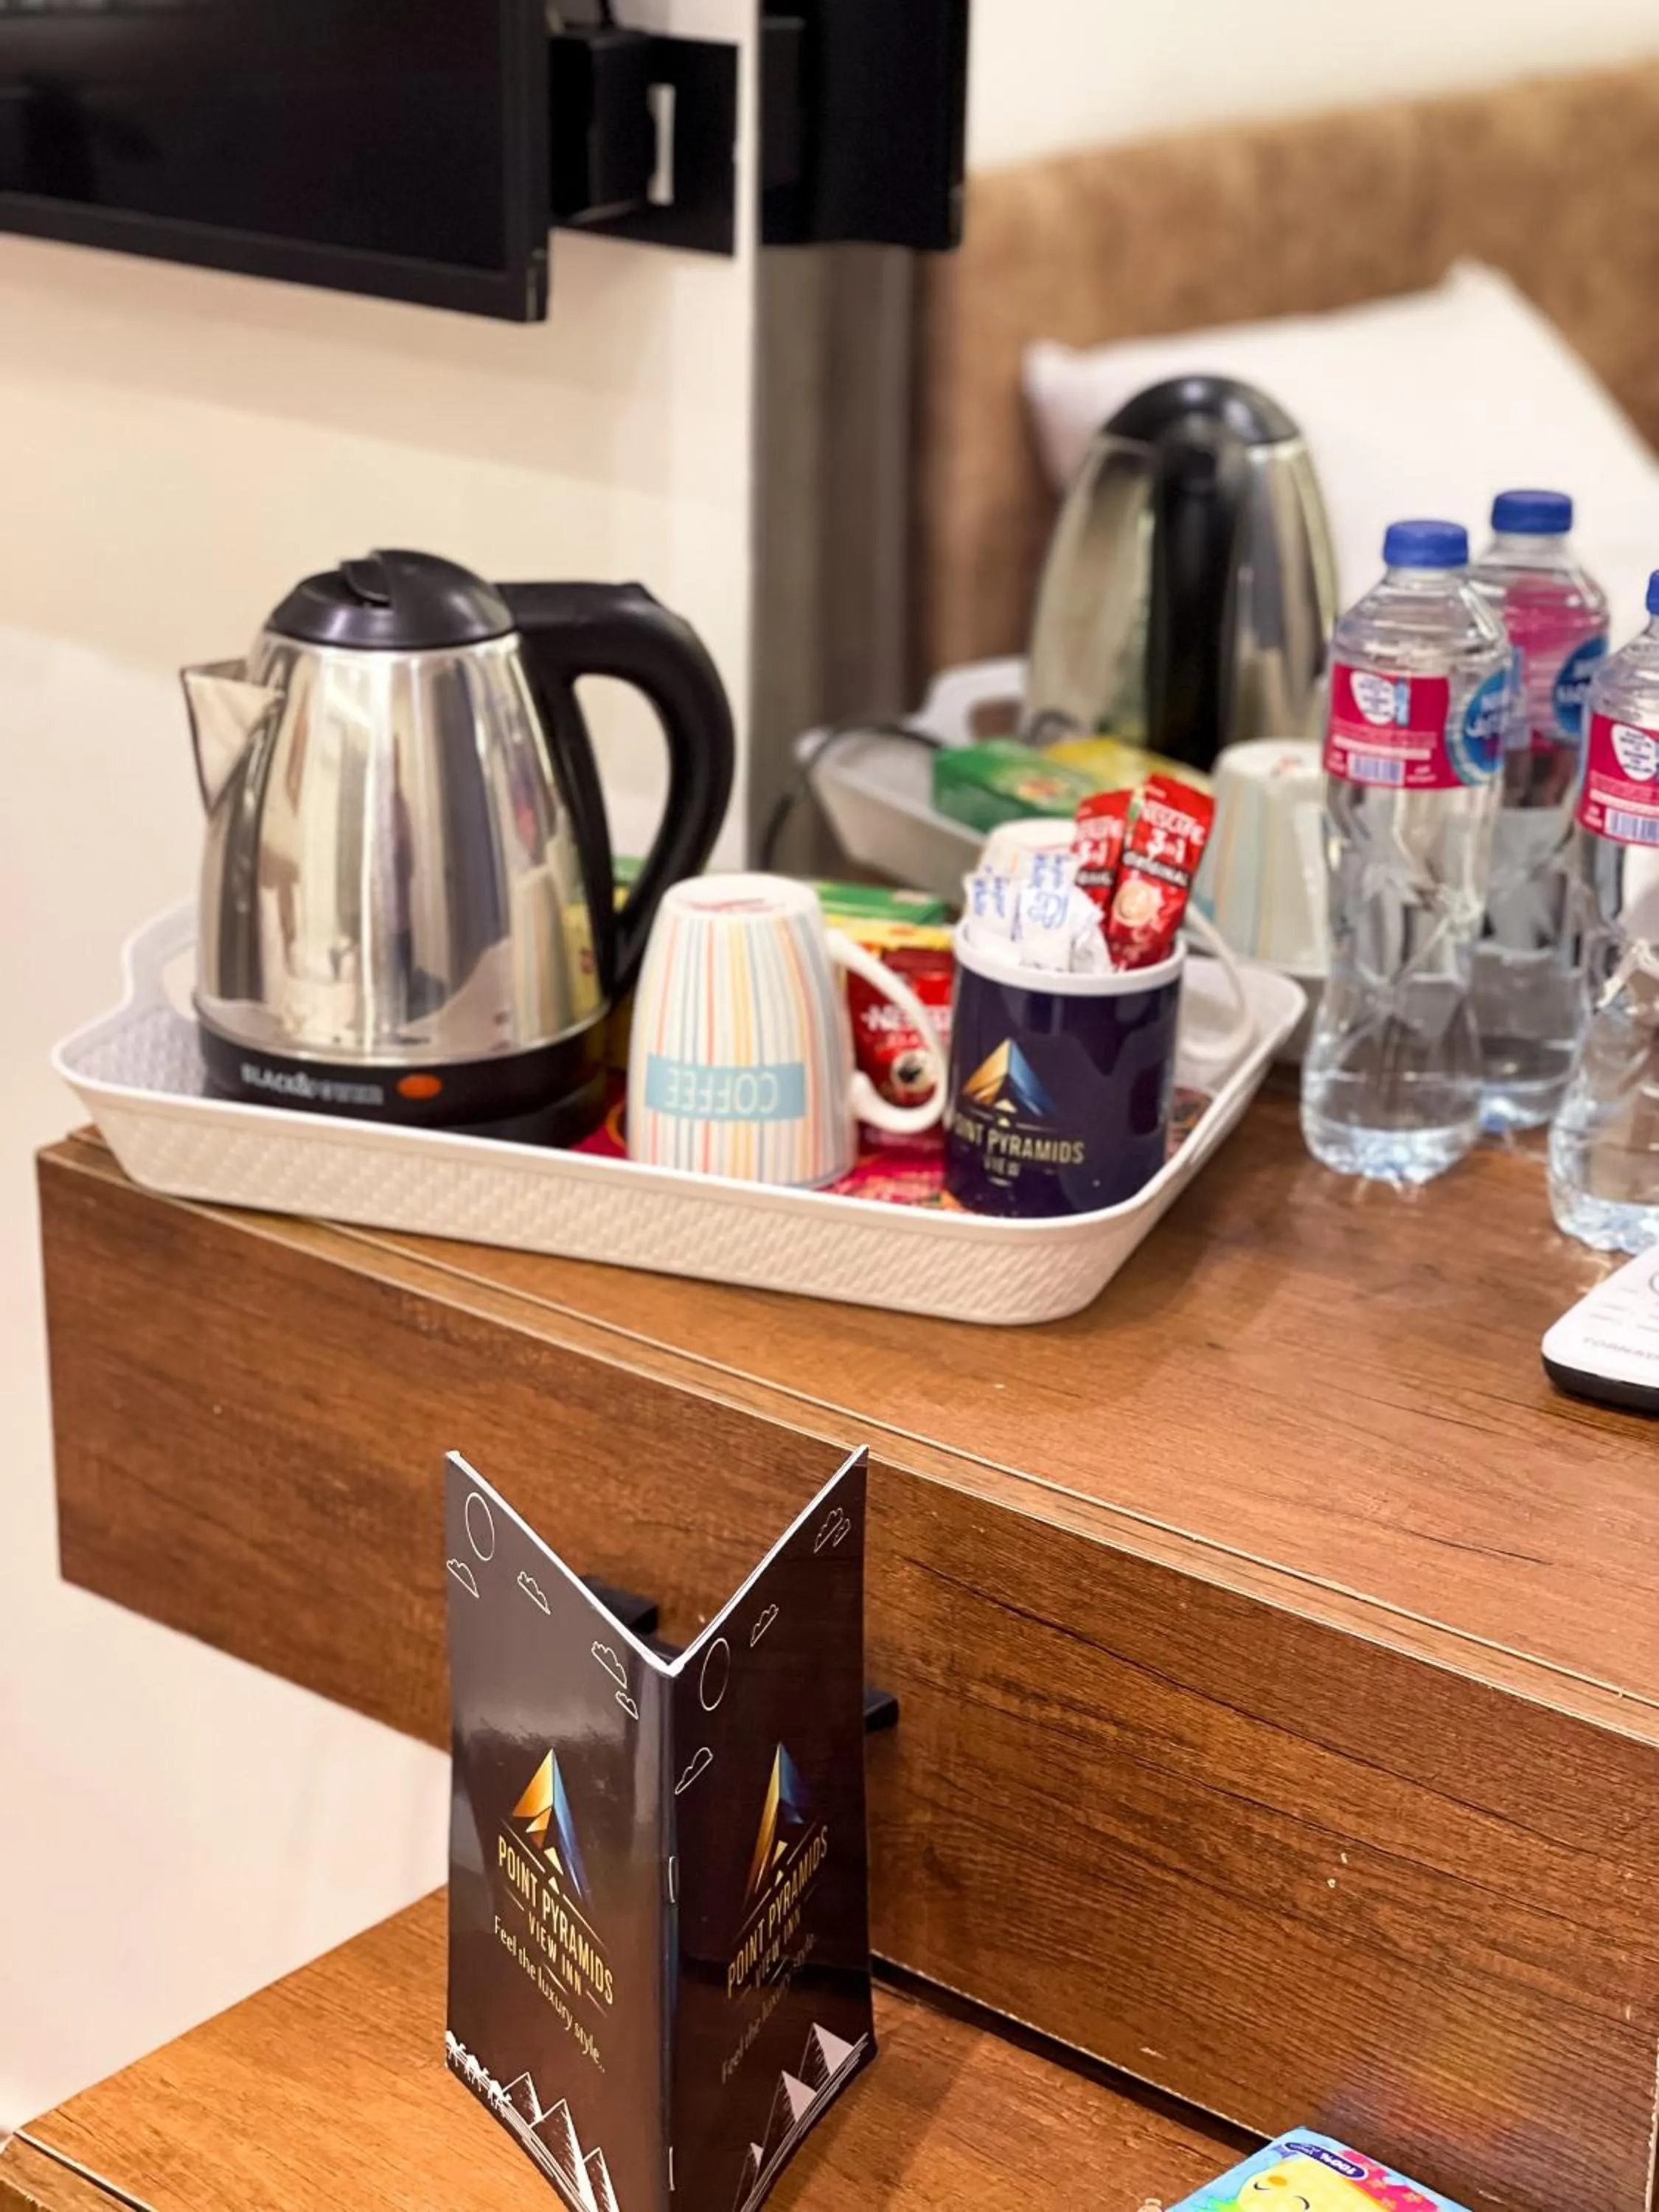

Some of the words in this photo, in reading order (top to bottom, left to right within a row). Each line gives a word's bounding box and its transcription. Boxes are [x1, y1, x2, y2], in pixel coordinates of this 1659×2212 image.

[664, 1068, 779, 1115] COFFEE
[988, 1128, 1085, 1164] PYRAMIDS
[498, 1834, 538, 1907] POINT
[542, 1888, 613, 2005] PYRAMIDS
[528, 1911, 557, 1964] VIEW
[562, 1954, 582, 1995] INN
[728, 1919, 765, 1999] POINT
[769, 1825, 828, 1938] PYRAMIDS
[495, 1915, 517, 1956] Feel
[518, 1947, 536, 1981] the
[538, 1966, 573, 2031] luxury
